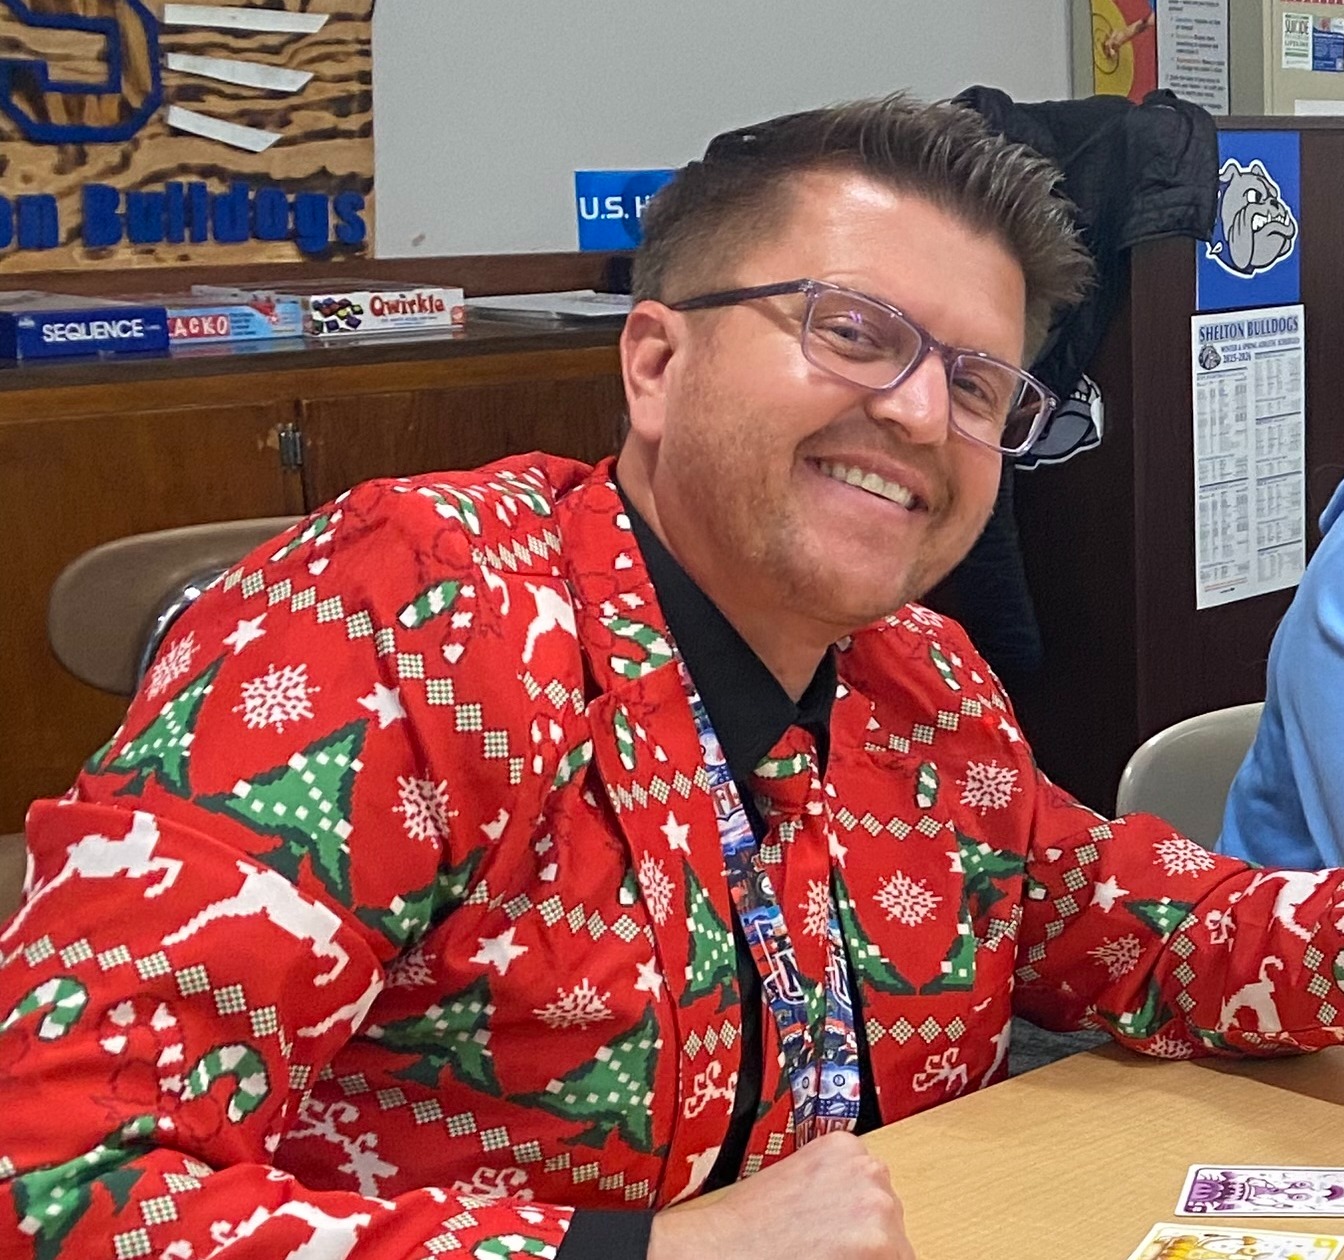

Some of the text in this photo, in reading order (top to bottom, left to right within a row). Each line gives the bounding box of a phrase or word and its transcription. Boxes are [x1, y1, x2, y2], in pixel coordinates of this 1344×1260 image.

[82, 181, 366, 254] Bulldogs
[579, 195, 655, 219] U.S. H
[369, 293, 446, 317] Qwirkle
[42, 319, 145, 342] SEQUENCE
[1199, 316, 1299, 343] SHELTON BULLDOGS
